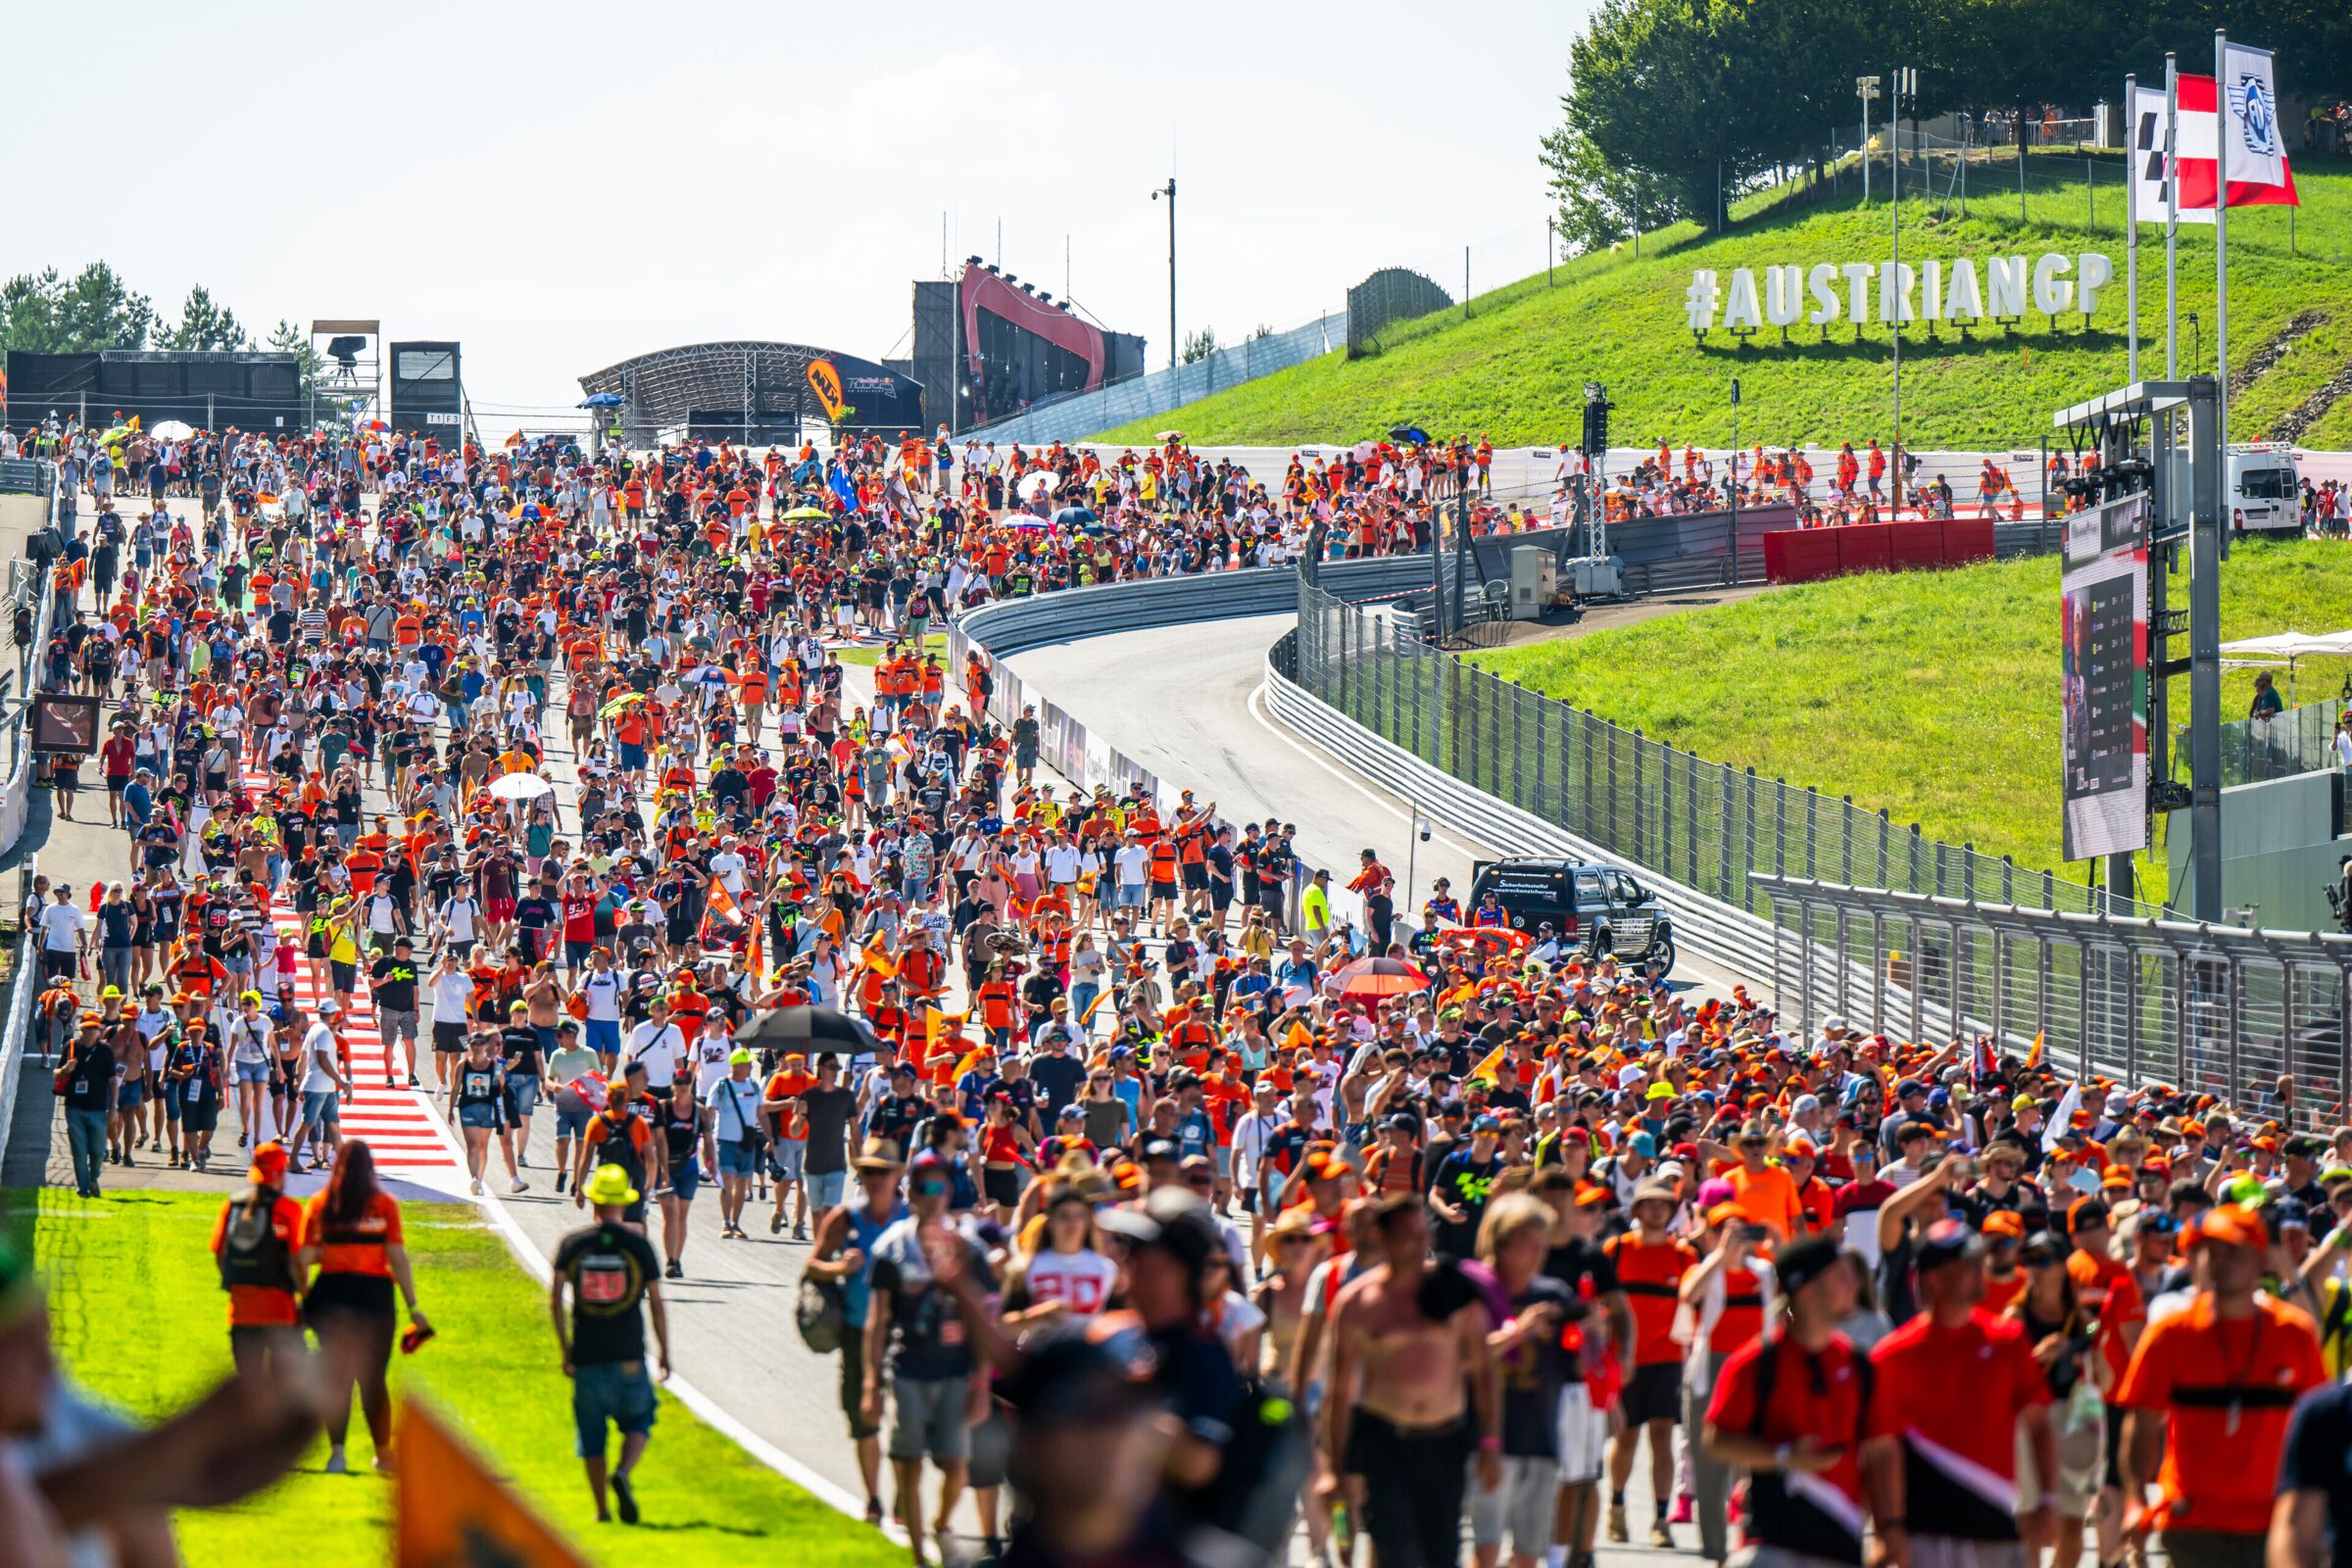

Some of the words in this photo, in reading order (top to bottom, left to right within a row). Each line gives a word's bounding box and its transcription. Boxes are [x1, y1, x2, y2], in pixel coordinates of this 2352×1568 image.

[1686, 253, 2114, 329] #AUSTRIANGP
[811, 369, 839, 408] KTM
[210, 914, 228, 926] 20
